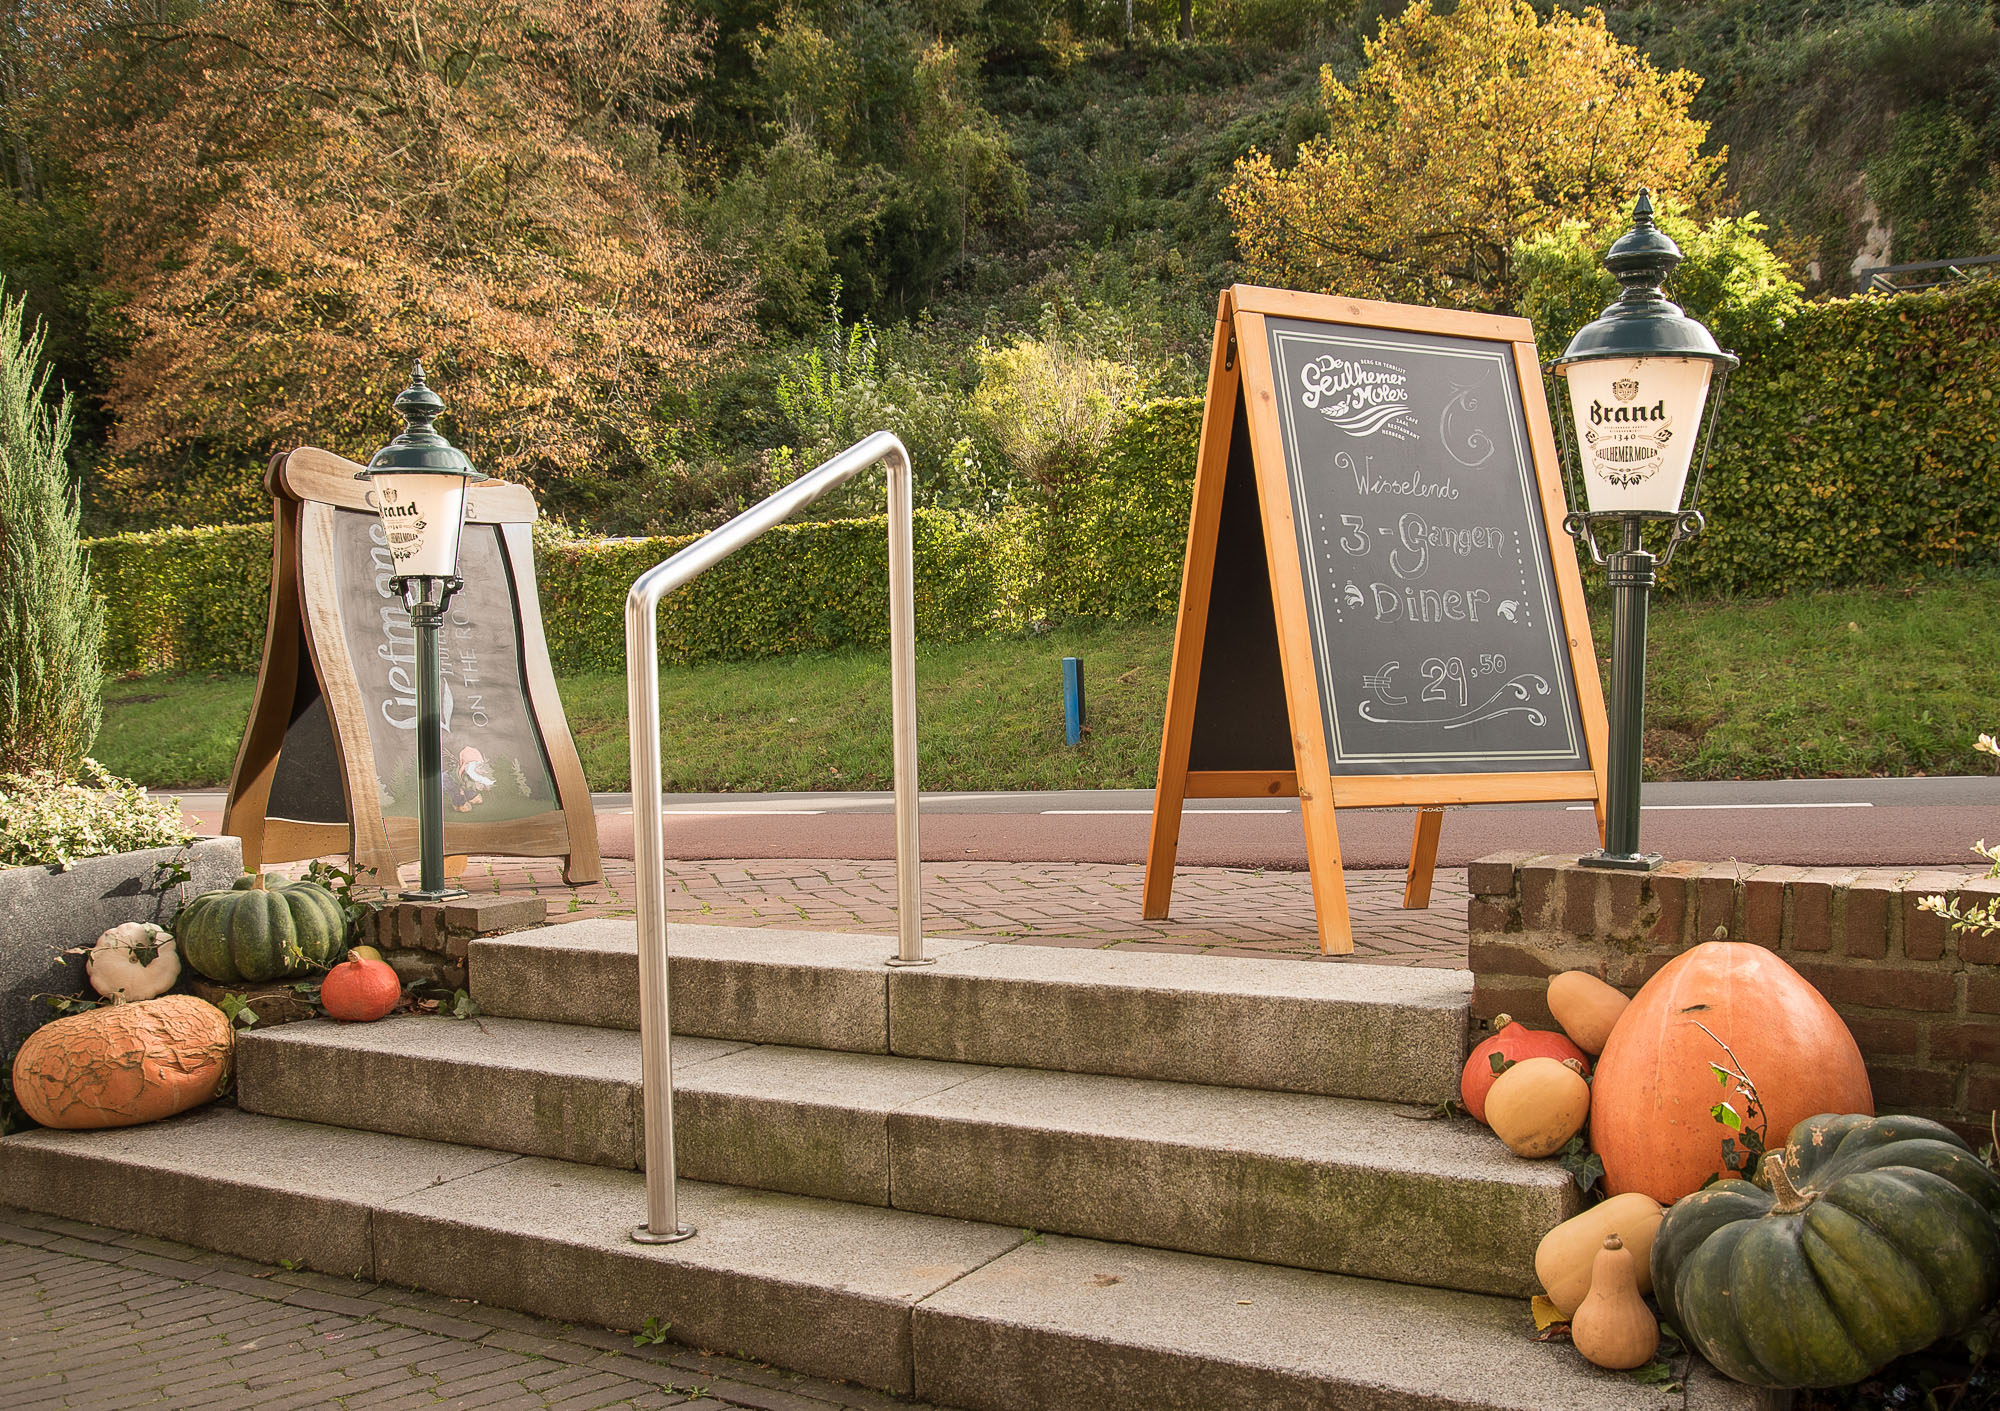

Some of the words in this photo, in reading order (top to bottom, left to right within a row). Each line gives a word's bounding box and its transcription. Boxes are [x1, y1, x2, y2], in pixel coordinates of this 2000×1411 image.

[1316, 354, 1344, 373] De
[1383, 362, 1406, 374] TERBLIJT
[1301, 361, 1407, 409] Geulhemer
[1590, 399, 1666, 426] Brand
[1381, 429, 1406, 441] HERBERG
[1387, 422, 1421, 441] RESTAURANT
[1613, 433, 1637, 442] 1340
[1334, 451, 1460, 500] Wisselend
[1390, 512, 1505, 580] Gangen
[1369, 582, 1491, 623] Diner
[460, 648, 481, 687] THE
[467, 695, 490, 728] ON
